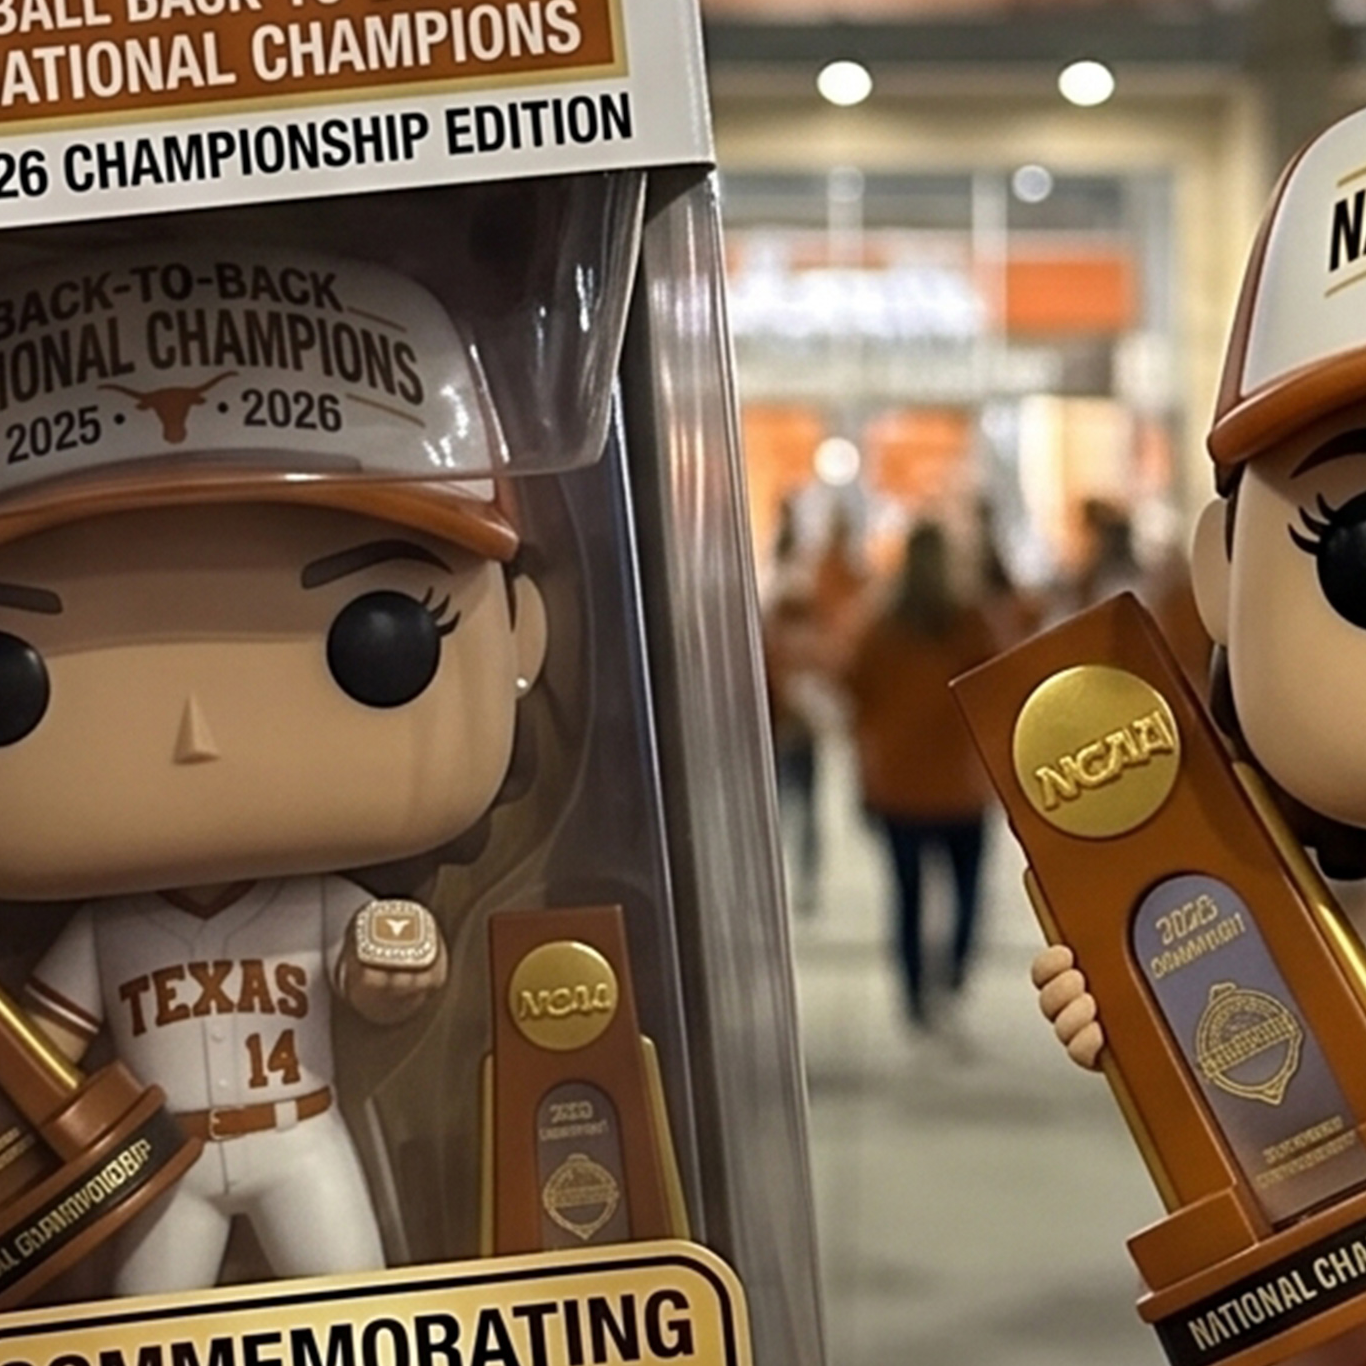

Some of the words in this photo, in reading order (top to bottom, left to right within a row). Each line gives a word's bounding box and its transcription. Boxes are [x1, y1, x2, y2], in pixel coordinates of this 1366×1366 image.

[63, 112, 429, 193] CHAMPIONSHIP
[445, 92, 632, 156] EDITION
[147, 309, 424, 406] CHAMPIONS
[5, 406, 102, 464] 2025
[241, 389, 342, 432] 2026
[119, 958, 308, 1036] TEXAS
[244, 1028, 303, 1089] 14
[1188, 1270, 1317, 1351] NATIONAL
